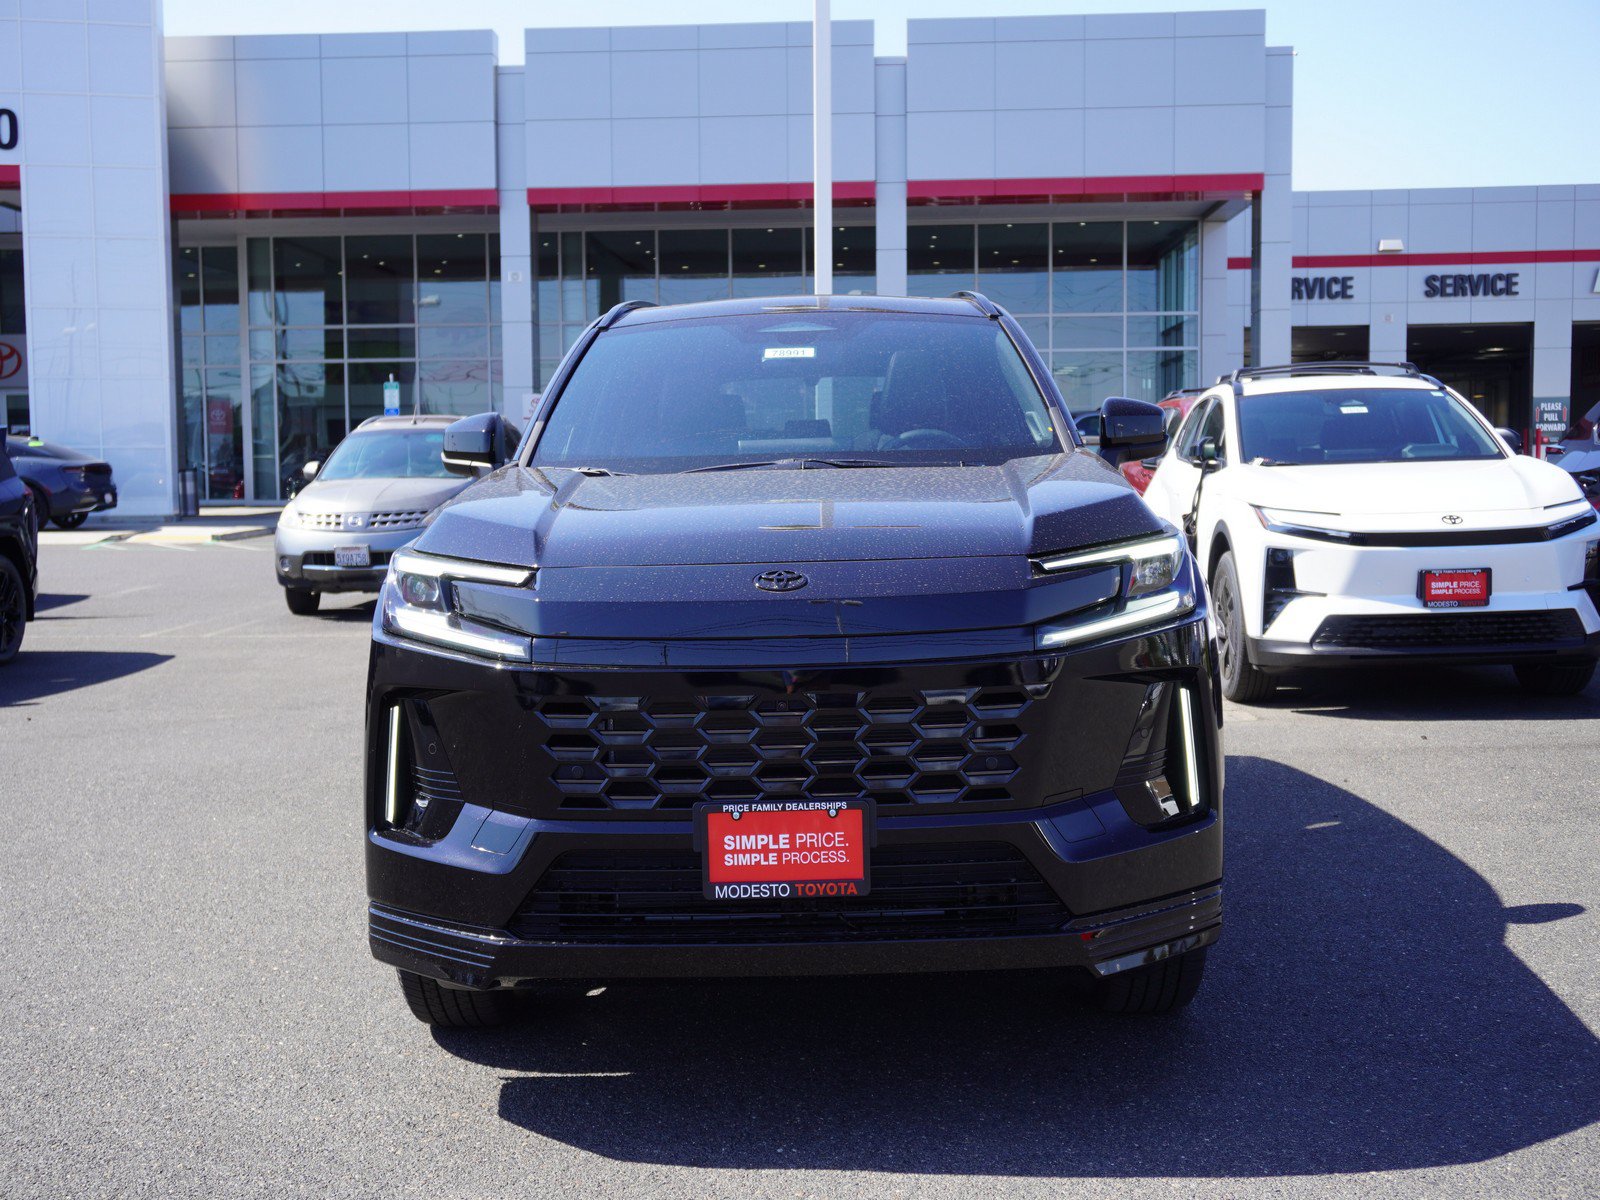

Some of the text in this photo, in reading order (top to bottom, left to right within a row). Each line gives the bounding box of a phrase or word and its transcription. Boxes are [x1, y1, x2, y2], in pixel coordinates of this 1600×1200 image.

[1292, 276, 1354, 300] RVICE
[1424, 273, 1520, 298] SERVICE
[1540, 402, 1562, 411] PLEASE
[1543, 413, 1559, 421] PULL
[1535, 423, 1567, 431] FORWARD
[722, 801, 848, 813] PRICE FAMILY DEALERSHIPS
[723, 832, 849, 851] SIMPLE PRICE.
[724, 850, 850, 866] SIMPLE PROCESS.
[715, 882, 858, 899] MODESTO TOYOTA
